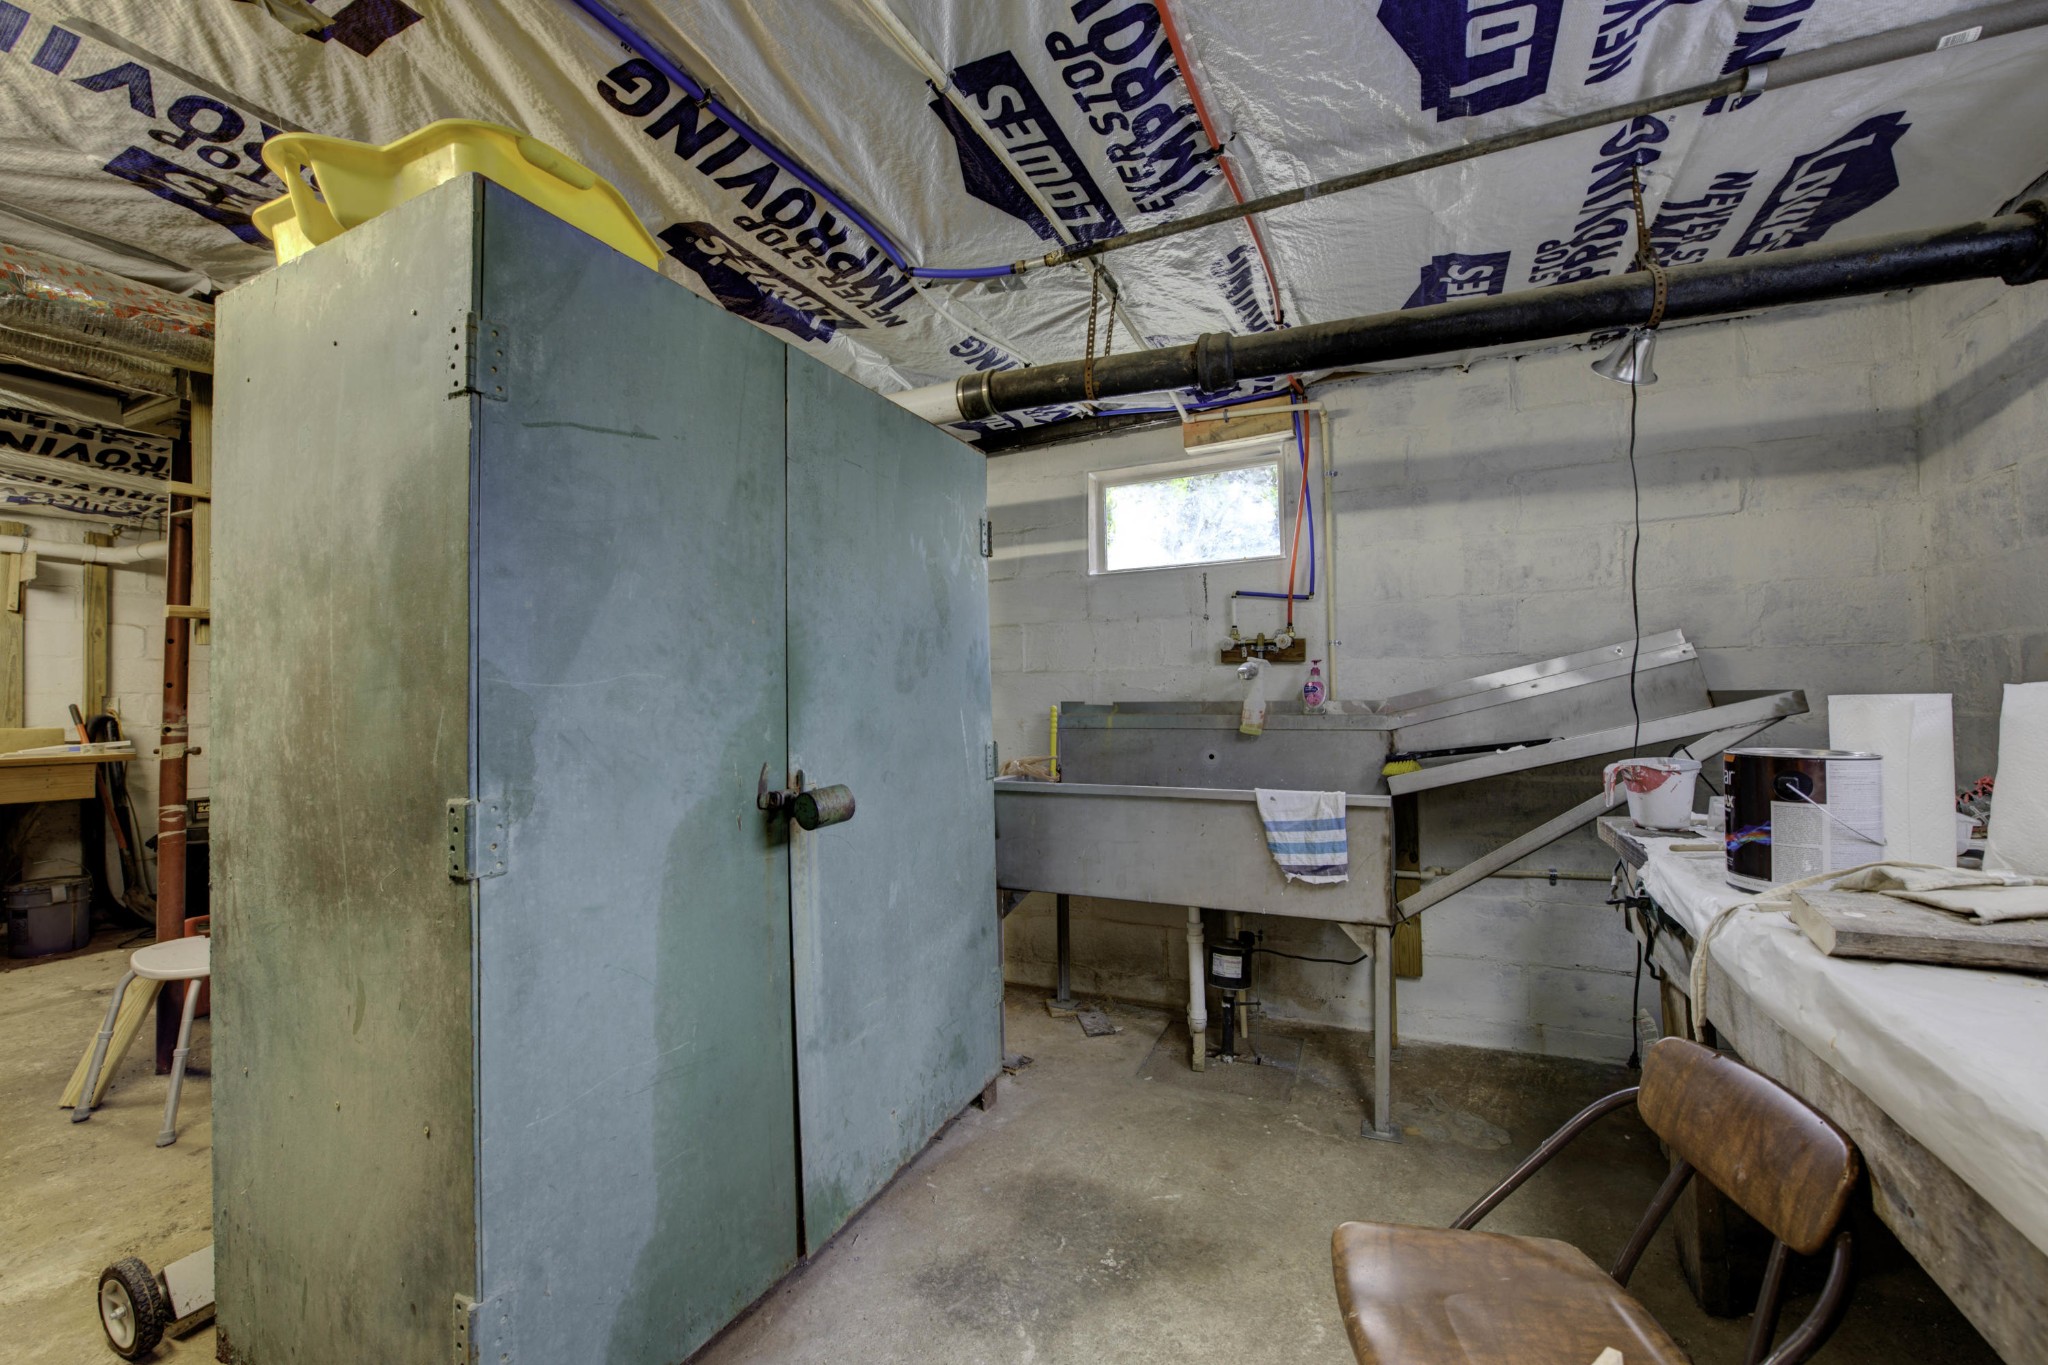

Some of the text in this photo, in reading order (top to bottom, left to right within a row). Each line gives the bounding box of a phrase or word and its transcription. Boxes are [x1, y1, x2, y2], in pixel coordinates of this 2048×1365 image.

[1045, 31, 1130, 135] STOP
[1450, 0, 1538, 99] LO
[597, 58, 918, 313] IMPROVING
[1550, 115, 1669, 287] PROVING
[1682, 169, 1759, 246] NEVER
[694, 235, 839, 330] LOWE'S
[733, 215, 908, 328] NEVER STOP
[1528, 239, 1570, 284] STOP
[0, 430, 168, 473] ROVIN
